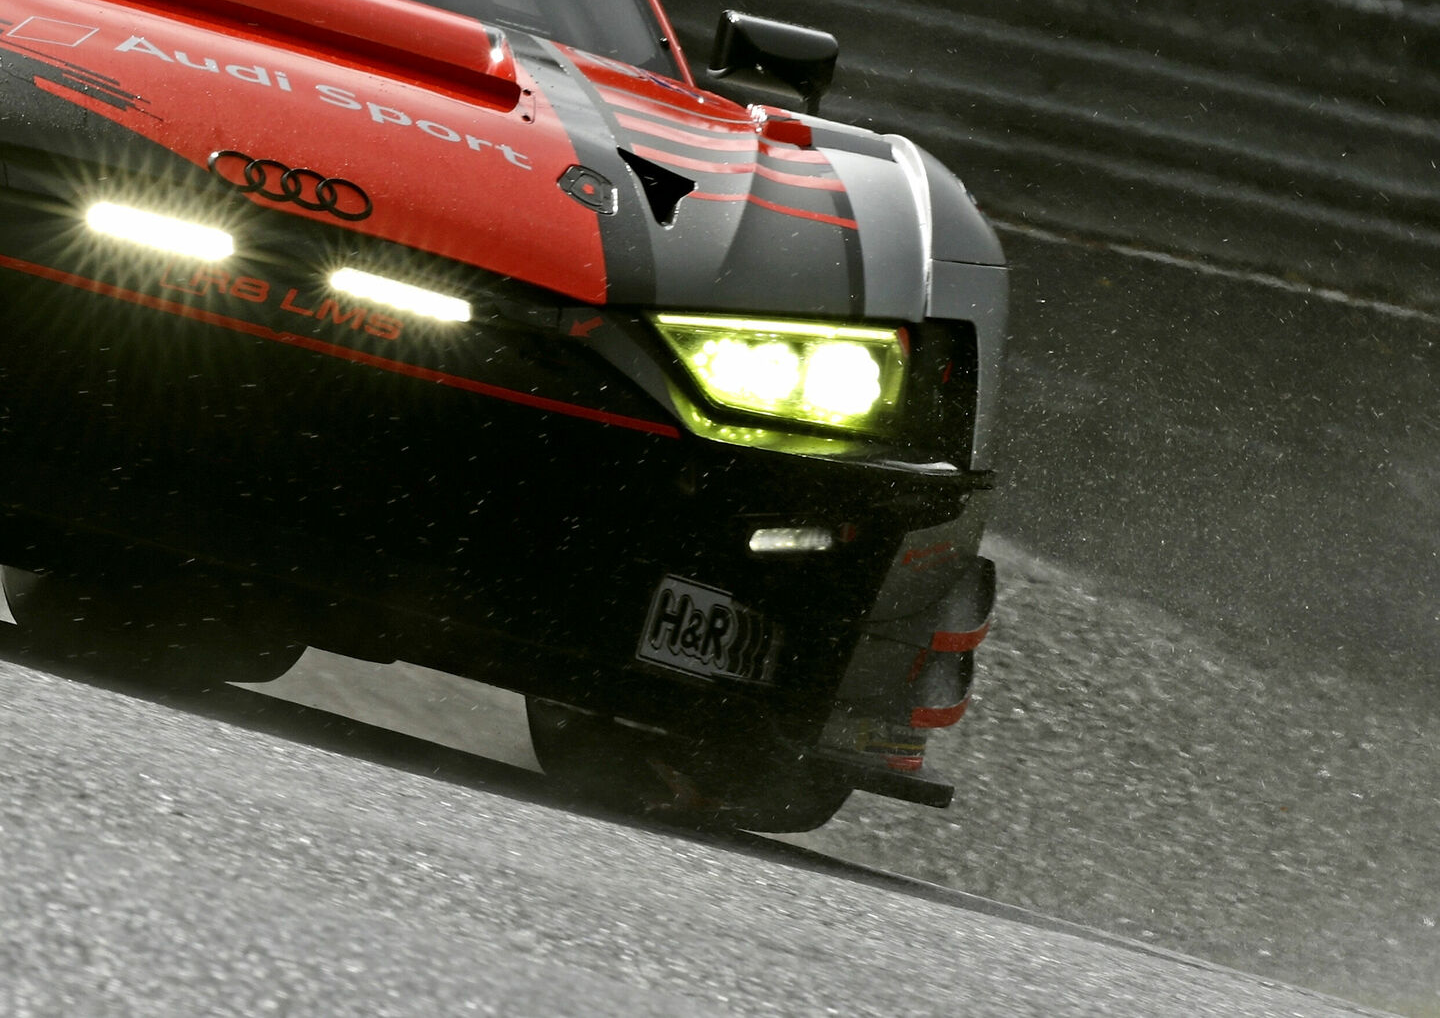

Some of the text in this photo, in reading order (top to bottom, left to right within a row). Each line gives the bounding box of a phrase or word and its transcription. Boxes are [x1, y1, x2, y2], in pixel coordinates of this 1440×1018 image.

[114, 35, 533, 171] Audi Sport
[188, 265, 404, 341] R8 LMS
[651, 590, 732, 664] H&R
